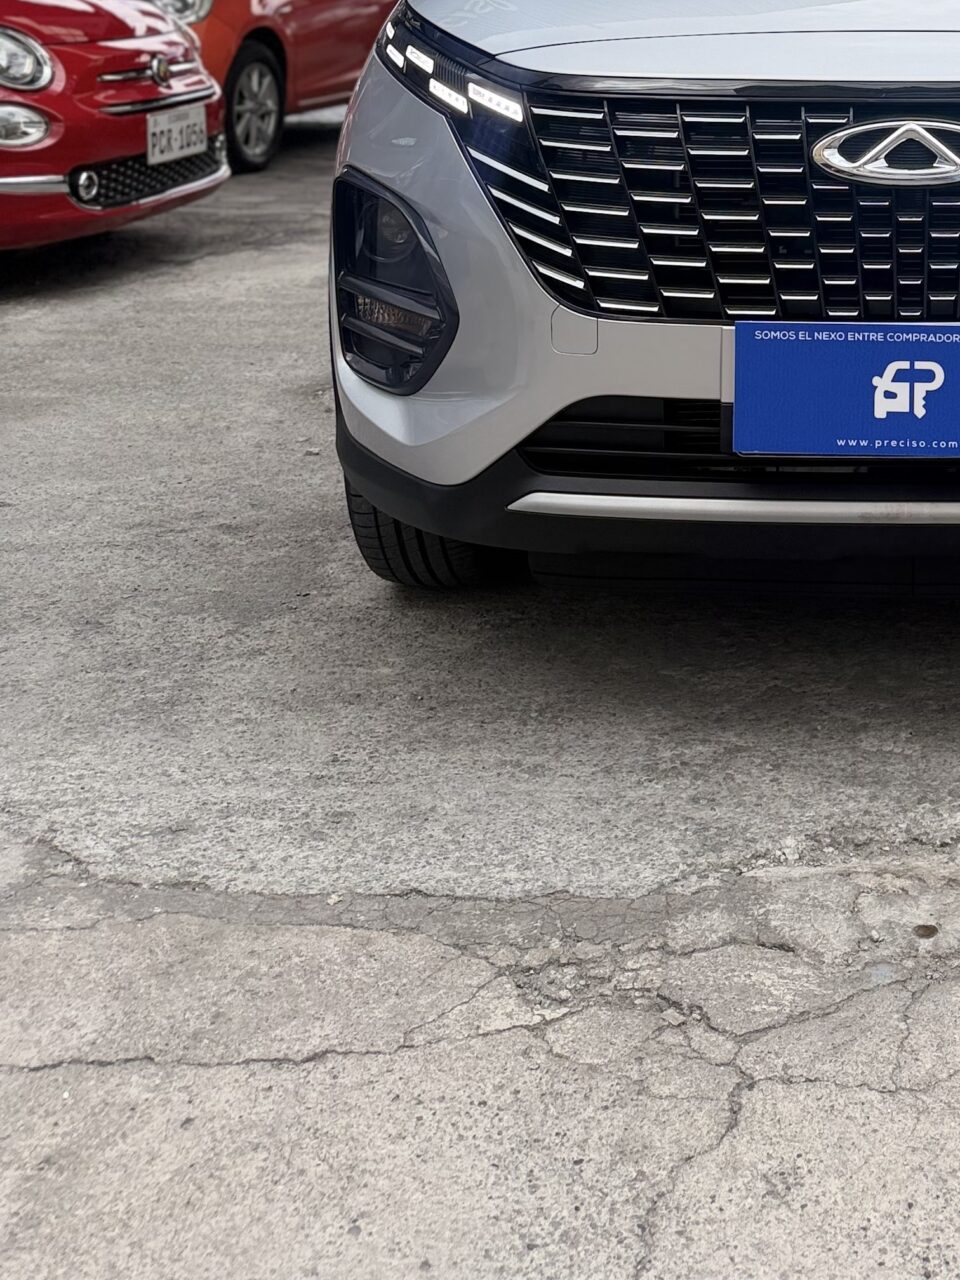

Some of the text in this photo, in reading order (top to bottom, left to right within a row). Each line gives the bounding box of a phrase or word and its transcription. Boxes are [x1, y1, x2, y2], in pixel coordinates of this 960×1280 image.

[754, 330, 796, 340] SOMOS
[798, 331, 812, 341] EL
[814, 331, 845, 341] NEXO
[847, 332, 884, 342] ENTRE
